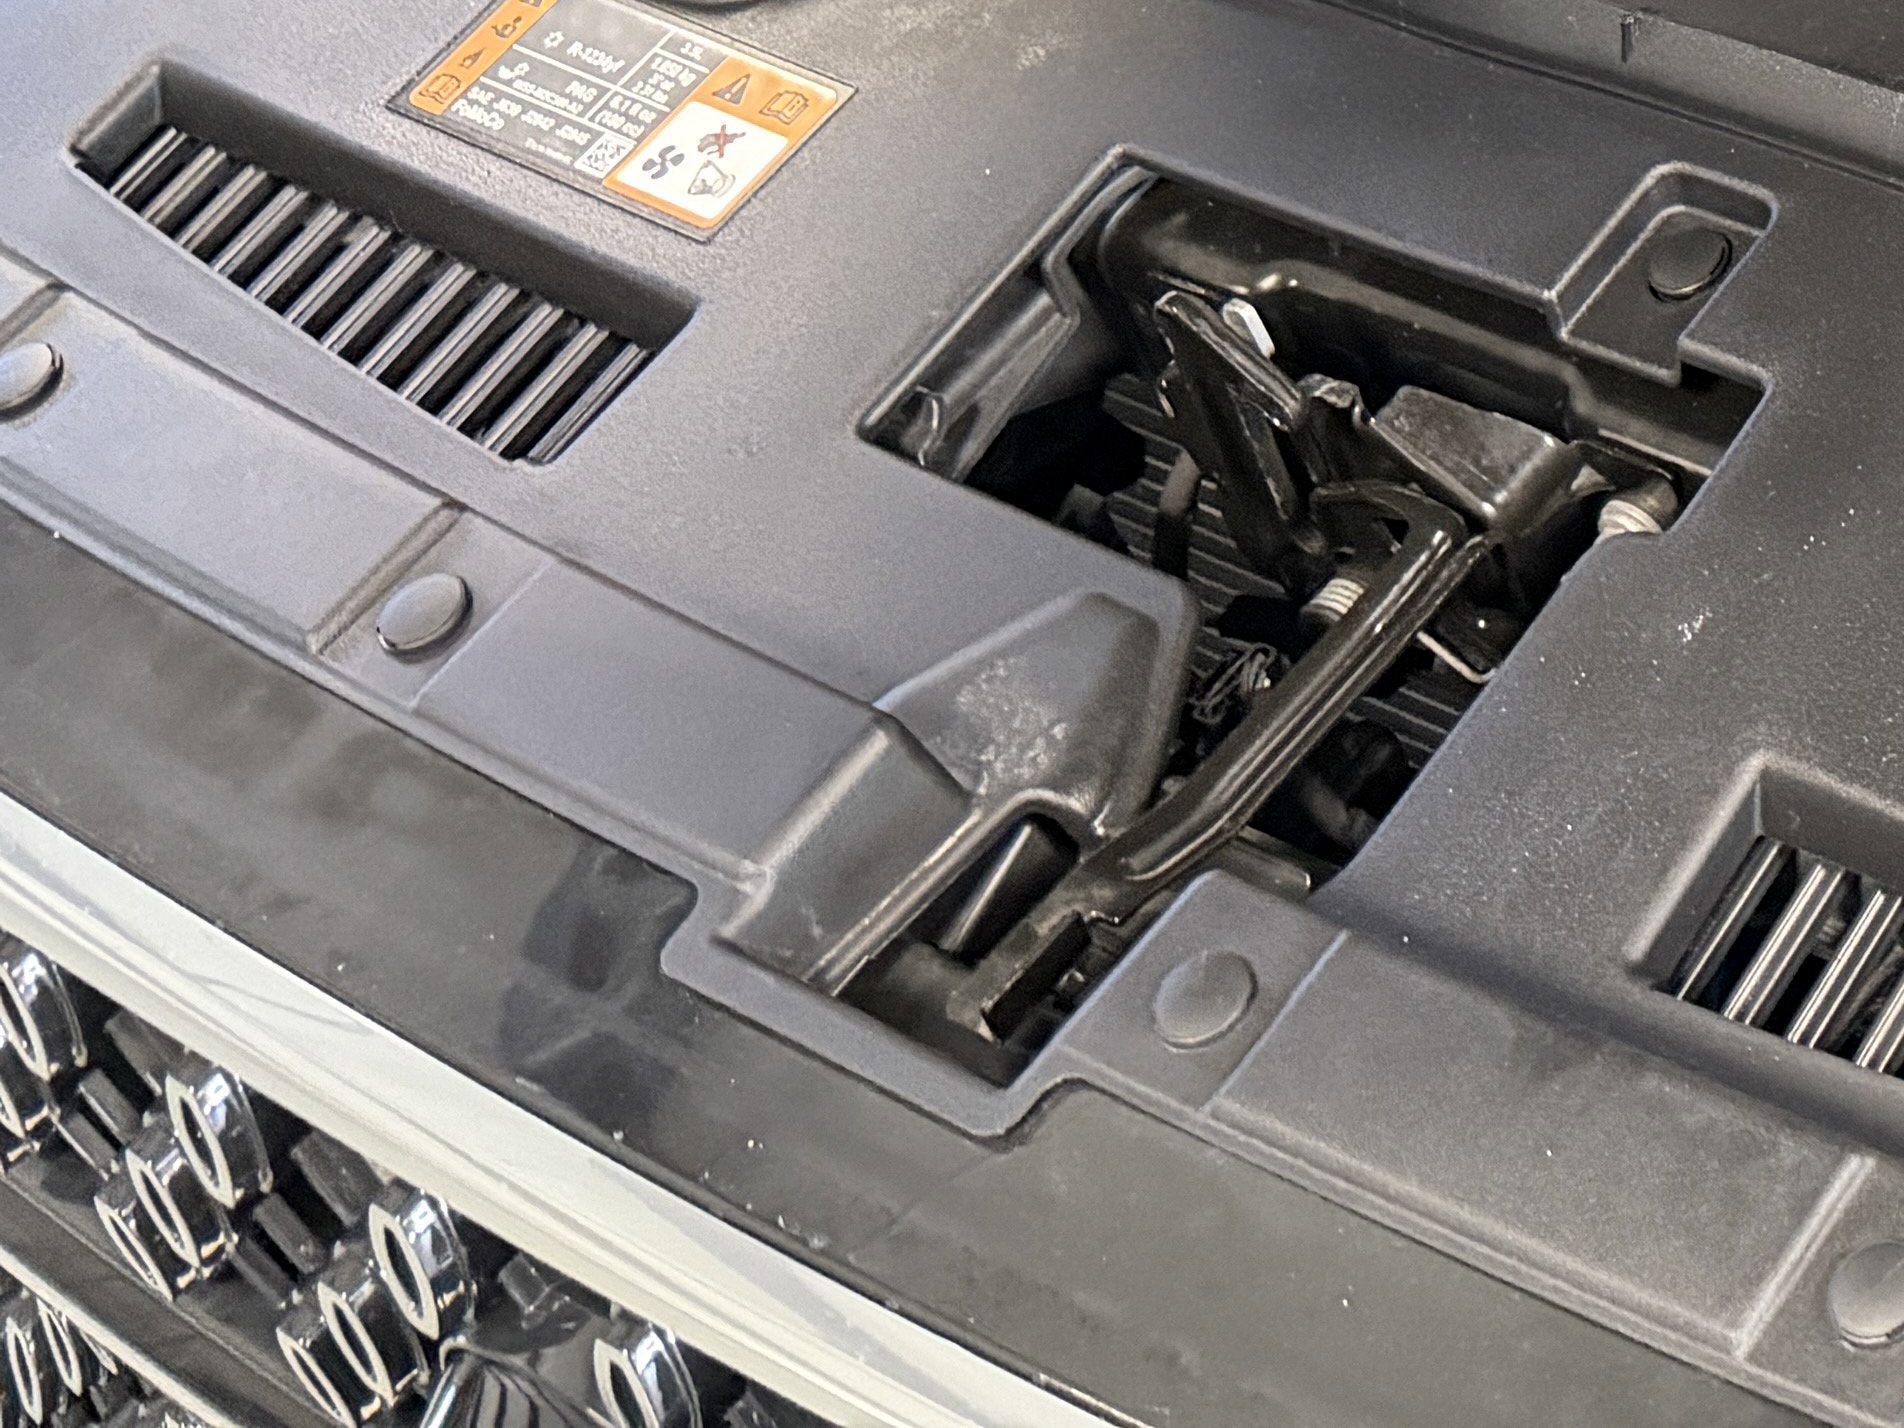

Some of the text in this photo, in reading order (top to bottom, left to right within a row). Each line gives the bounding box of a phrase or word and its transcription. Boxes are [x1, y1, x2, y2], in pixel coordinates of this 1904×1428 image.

[467, 86, 495, 105] SAE
[565, 80, 598, 103] PAG
[451, 99, 505, 131] FoMoCo
